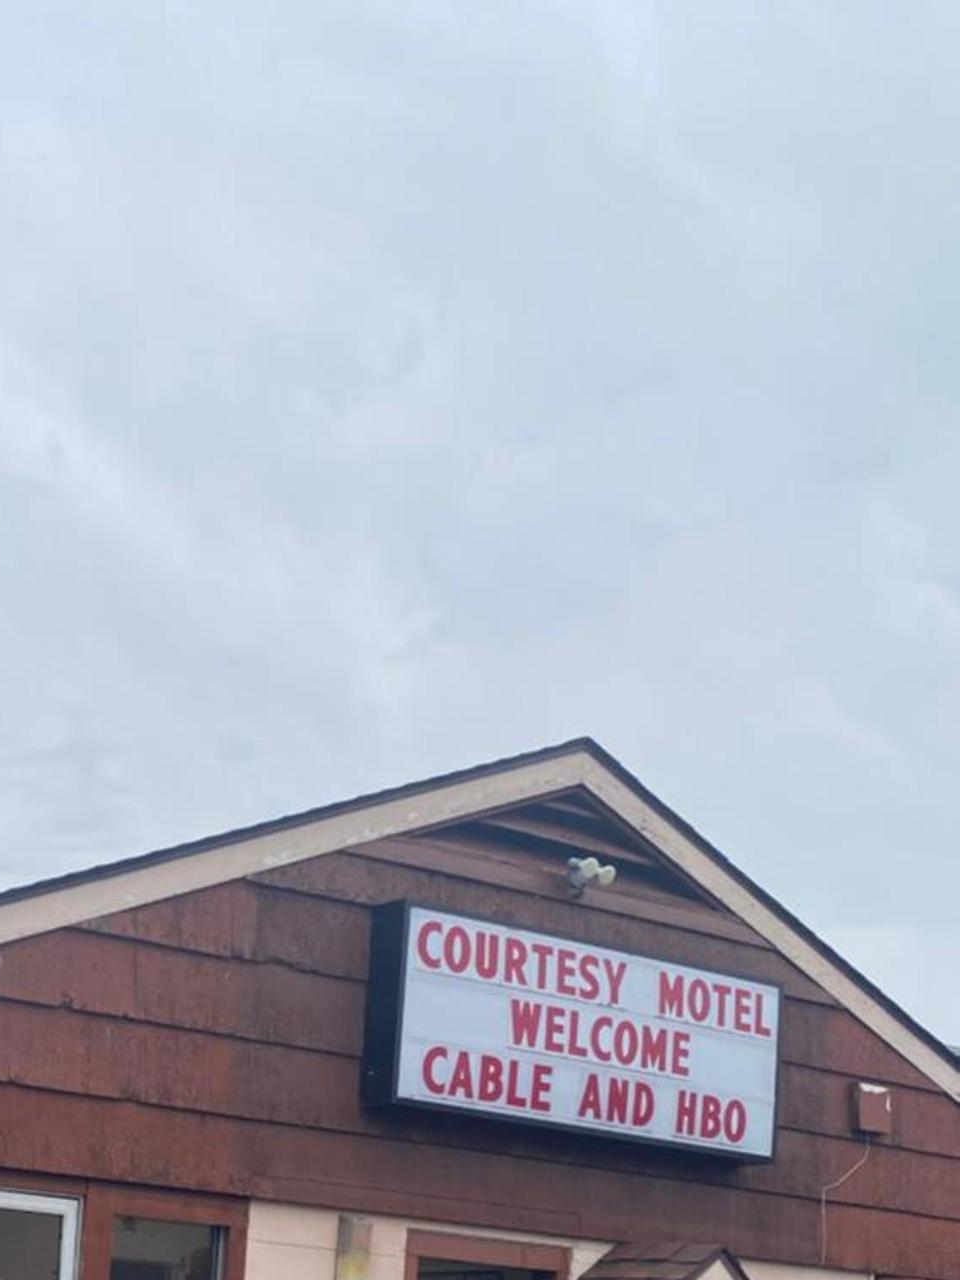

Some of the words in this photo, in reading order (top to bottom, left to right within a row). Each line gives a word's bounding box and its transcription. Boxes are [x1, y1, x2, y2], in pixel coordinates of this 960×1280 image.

[417, 921, 627, 1006] COURTESY
[658, 971, 771, 1037] MOTEL
[510, 999, 691, 1076] WELCOME
[422, 1046, 553, 1112] CABLE
[577, 1073, 655, 1127] AND
[675, 1090, 747, 1143] HBO
